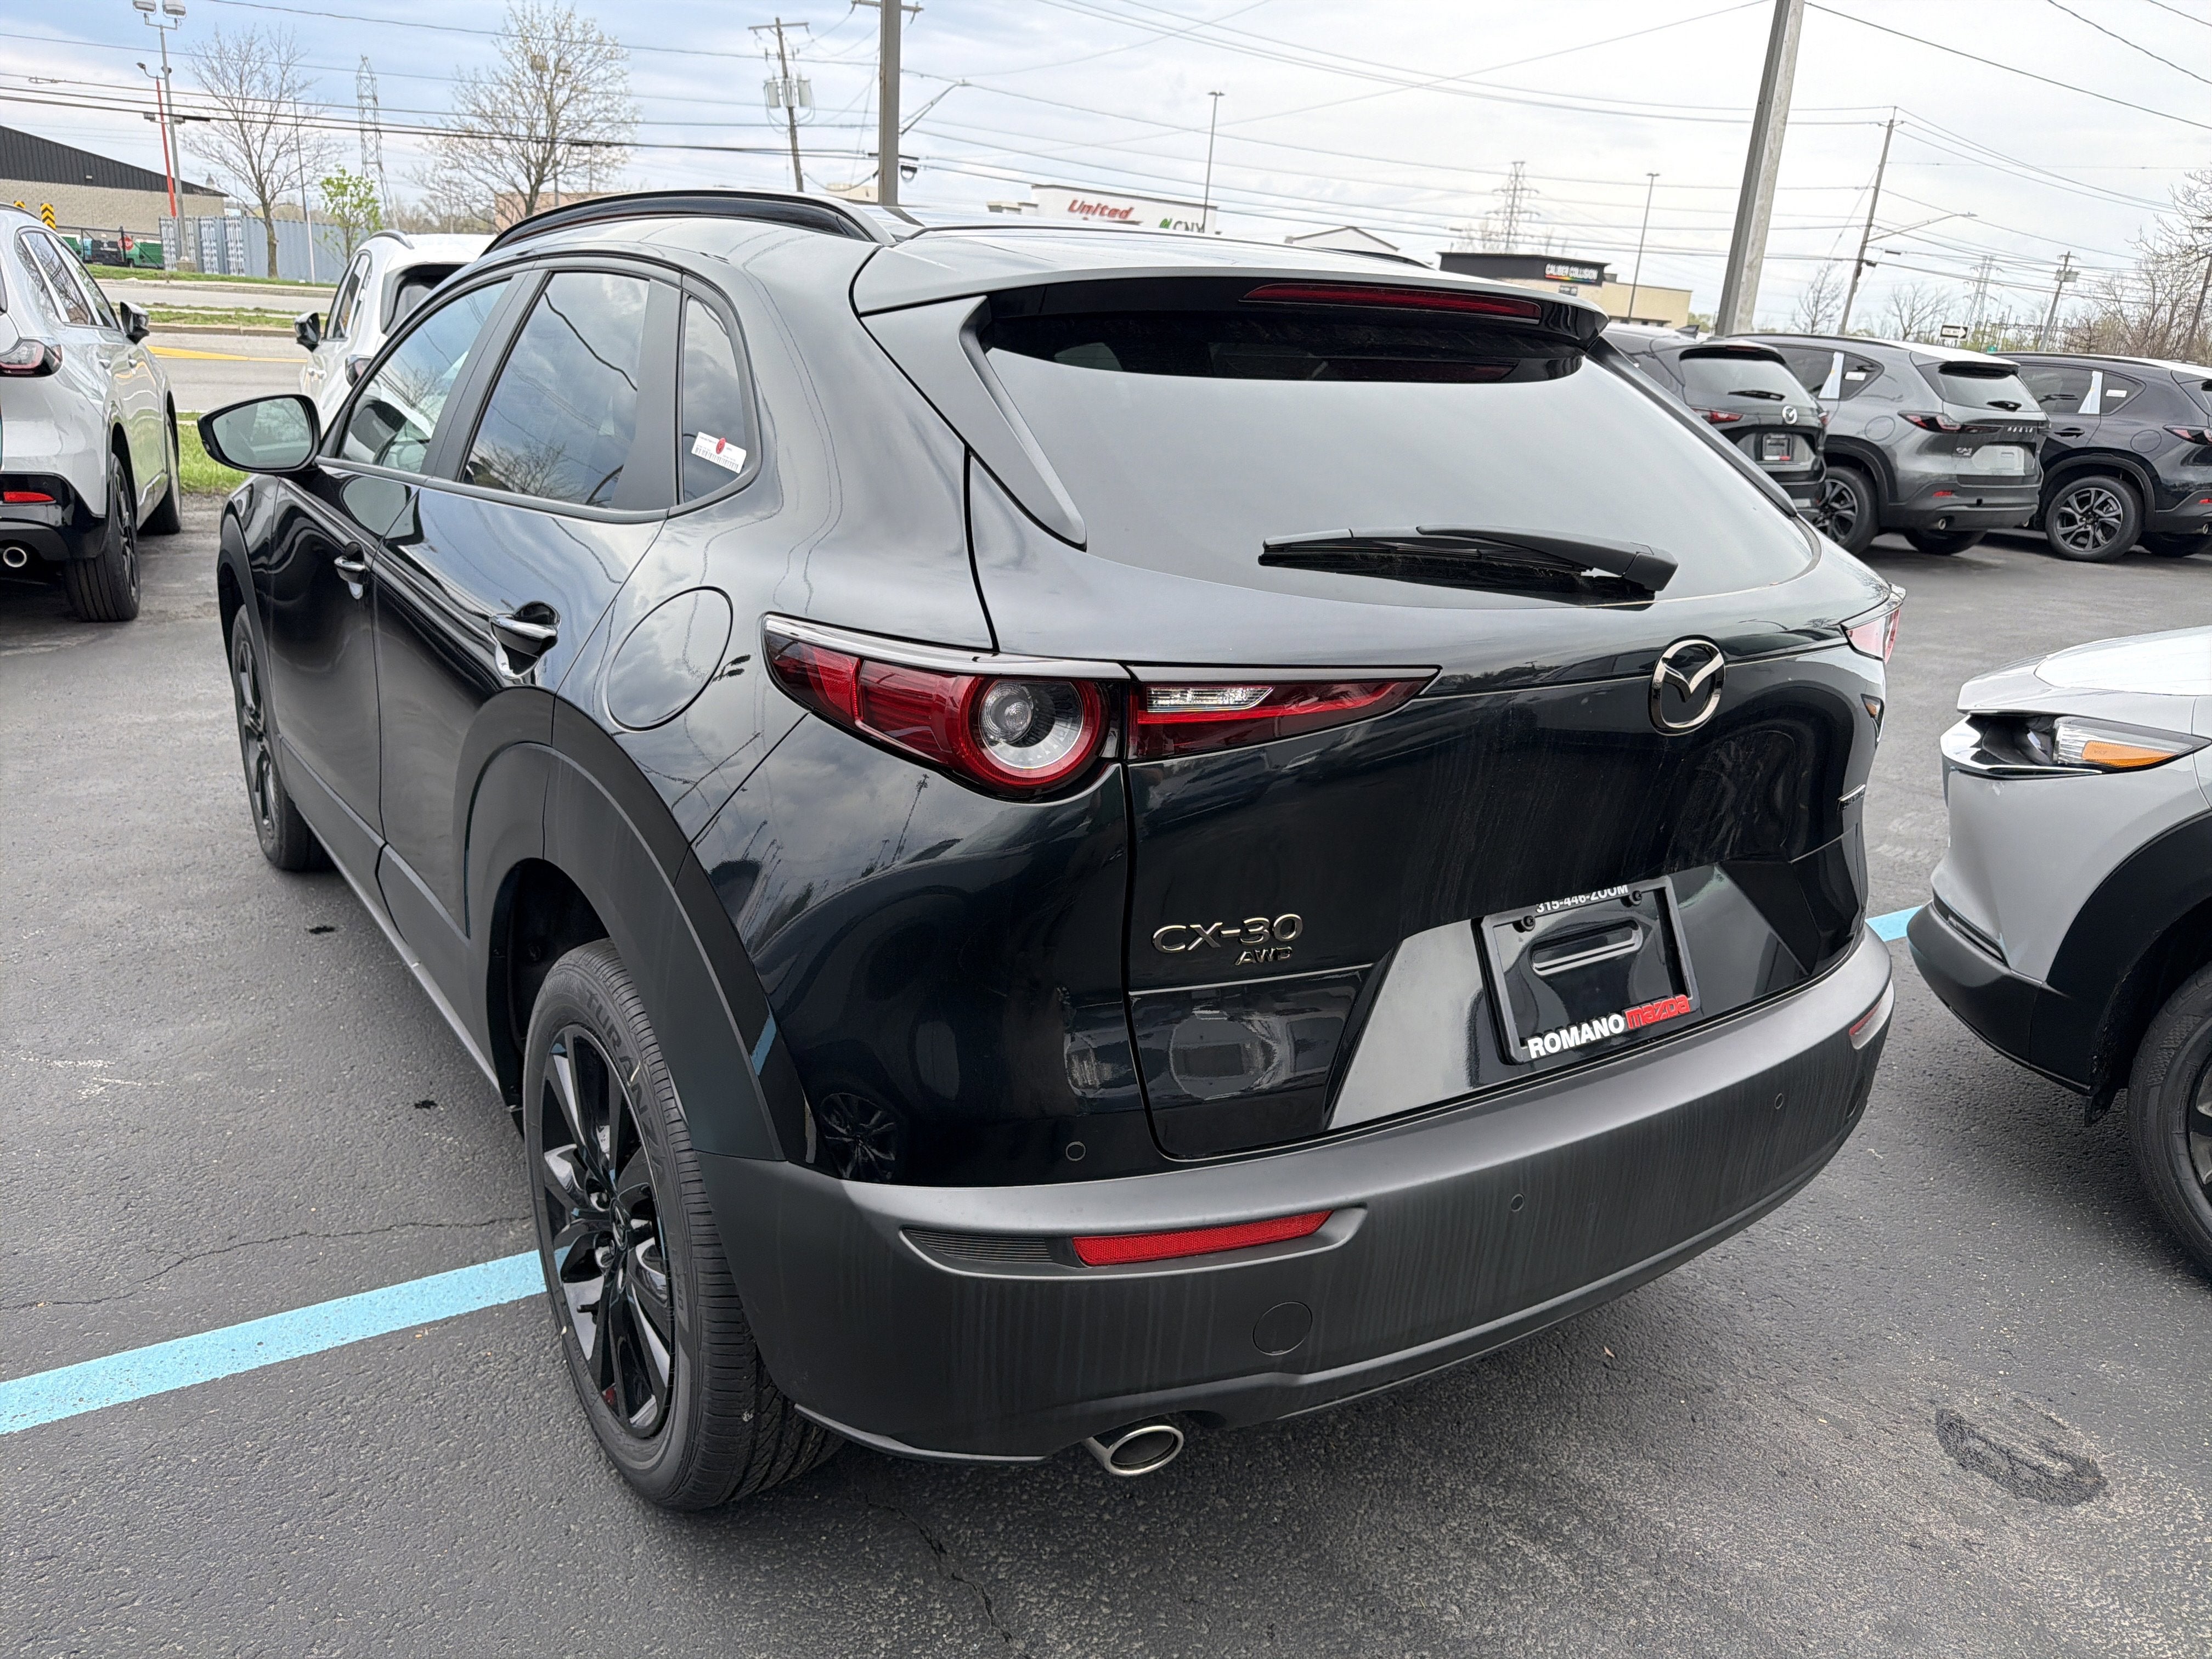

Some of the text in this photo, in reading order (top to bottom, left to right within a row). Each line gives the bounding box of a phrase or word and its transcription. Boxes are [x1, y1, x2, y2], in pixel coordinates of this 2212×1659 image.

[1068, 199, 1135, 219] United
[1153, 913, 1304, 954] CX-30
[1234, 945, 1293, 966] AWD
[1527, 1013, 1625, 1059] ROMANO
